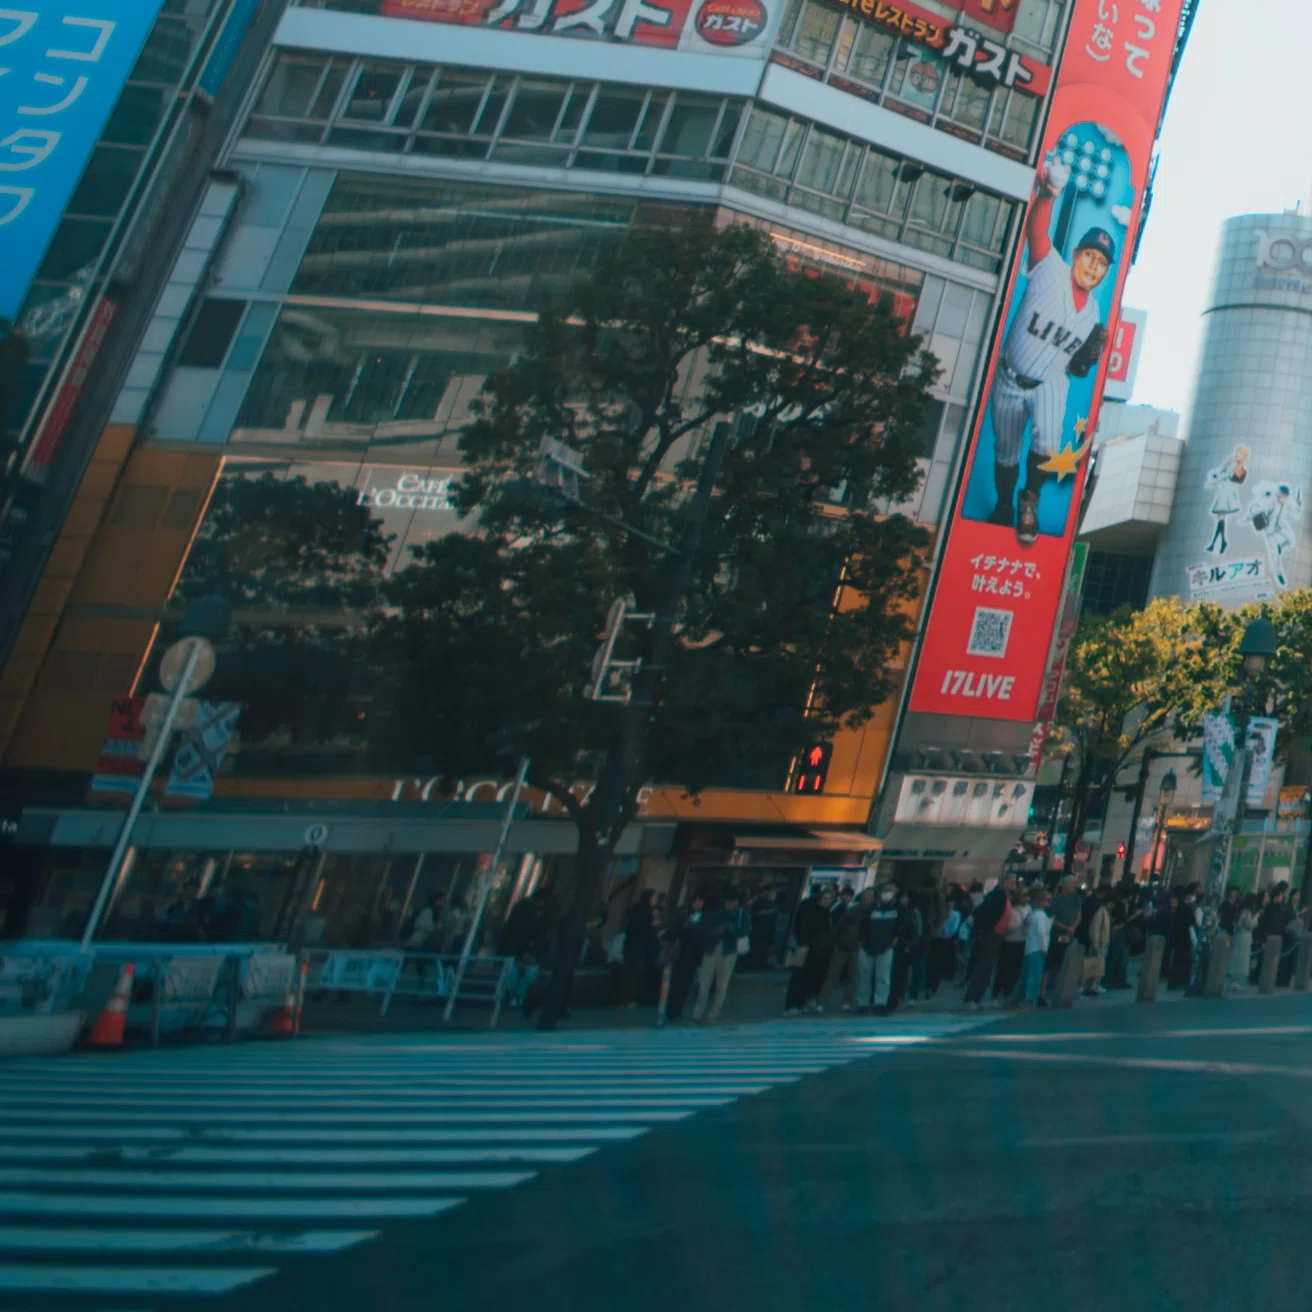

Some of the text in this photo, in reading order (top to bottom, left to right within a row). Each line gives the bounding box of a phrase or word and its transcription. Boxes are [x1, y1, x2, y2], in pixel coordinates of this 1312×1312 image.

[704, 14, 758, 32] ガスト
[944, 26, 1032, 87] ガスト
[1027, 312, 1082, 354] LIVE
[970, 554, 1041, 579] イチナナで、
[971, 576, 1031, 599] 叶えよう。
[941, 670, 1016, 700] 17LIVE
